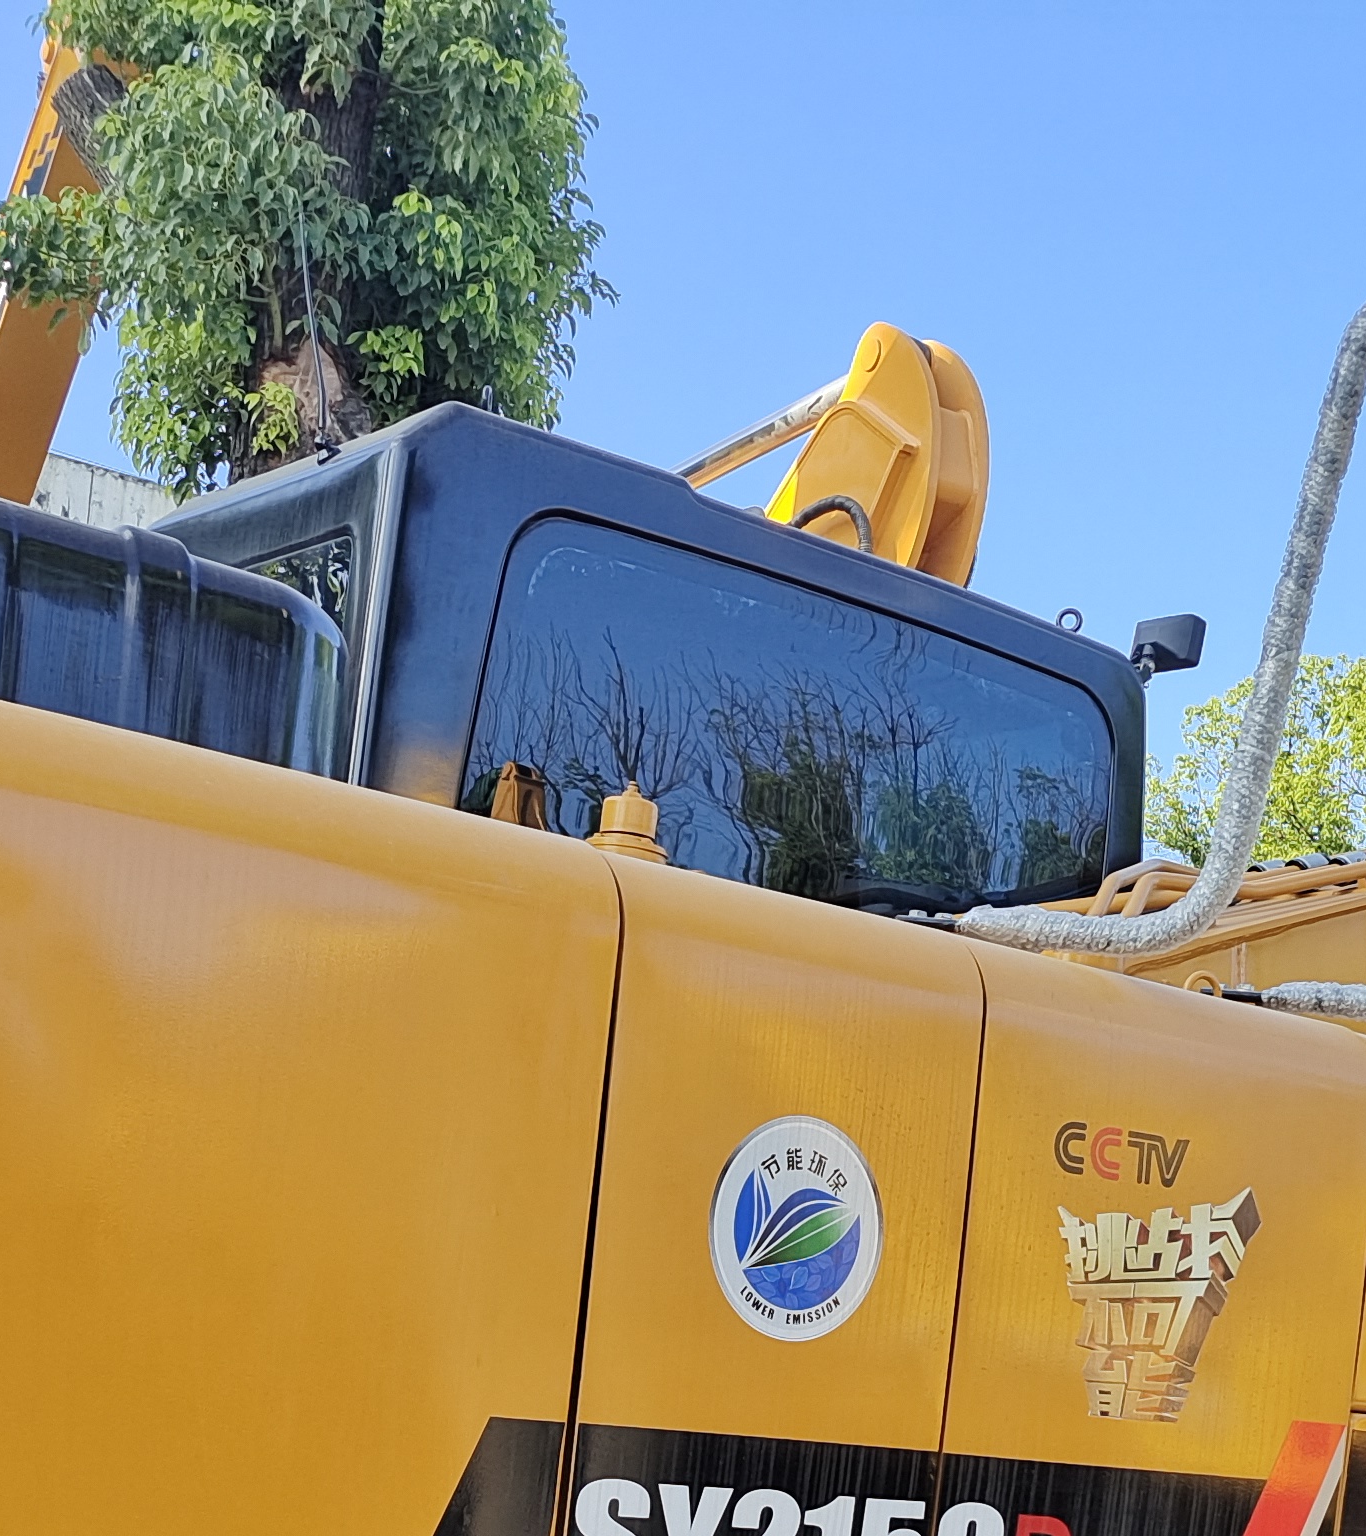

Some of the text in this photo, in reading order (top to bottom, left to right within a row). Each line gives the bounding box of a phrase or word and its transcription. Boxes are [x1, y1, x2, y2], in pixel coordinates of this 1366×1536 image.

[761, 1147, 848, 1197] 节能环保
[1054, 1121, 1190, 1188] CCTV
[739, 1285, 841, 1325] LOWER EMISSION
